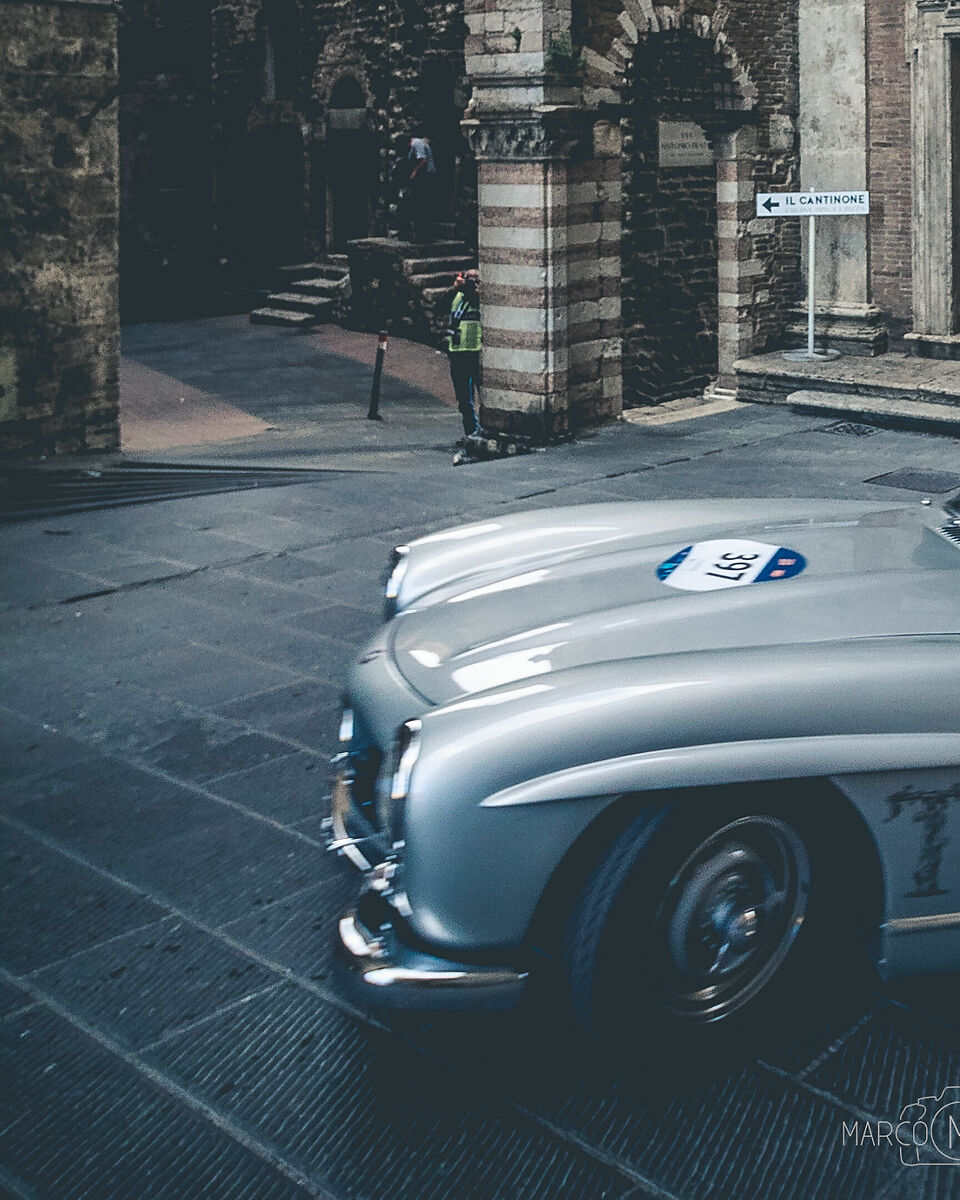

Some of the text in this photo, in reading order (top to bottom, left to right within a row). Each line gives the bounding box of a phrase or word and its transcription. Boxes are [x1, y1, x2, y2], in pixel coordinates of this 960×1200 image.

[785, 194, 865, 206] IL CANTINONE
[705, 552, 759, 581] 397
